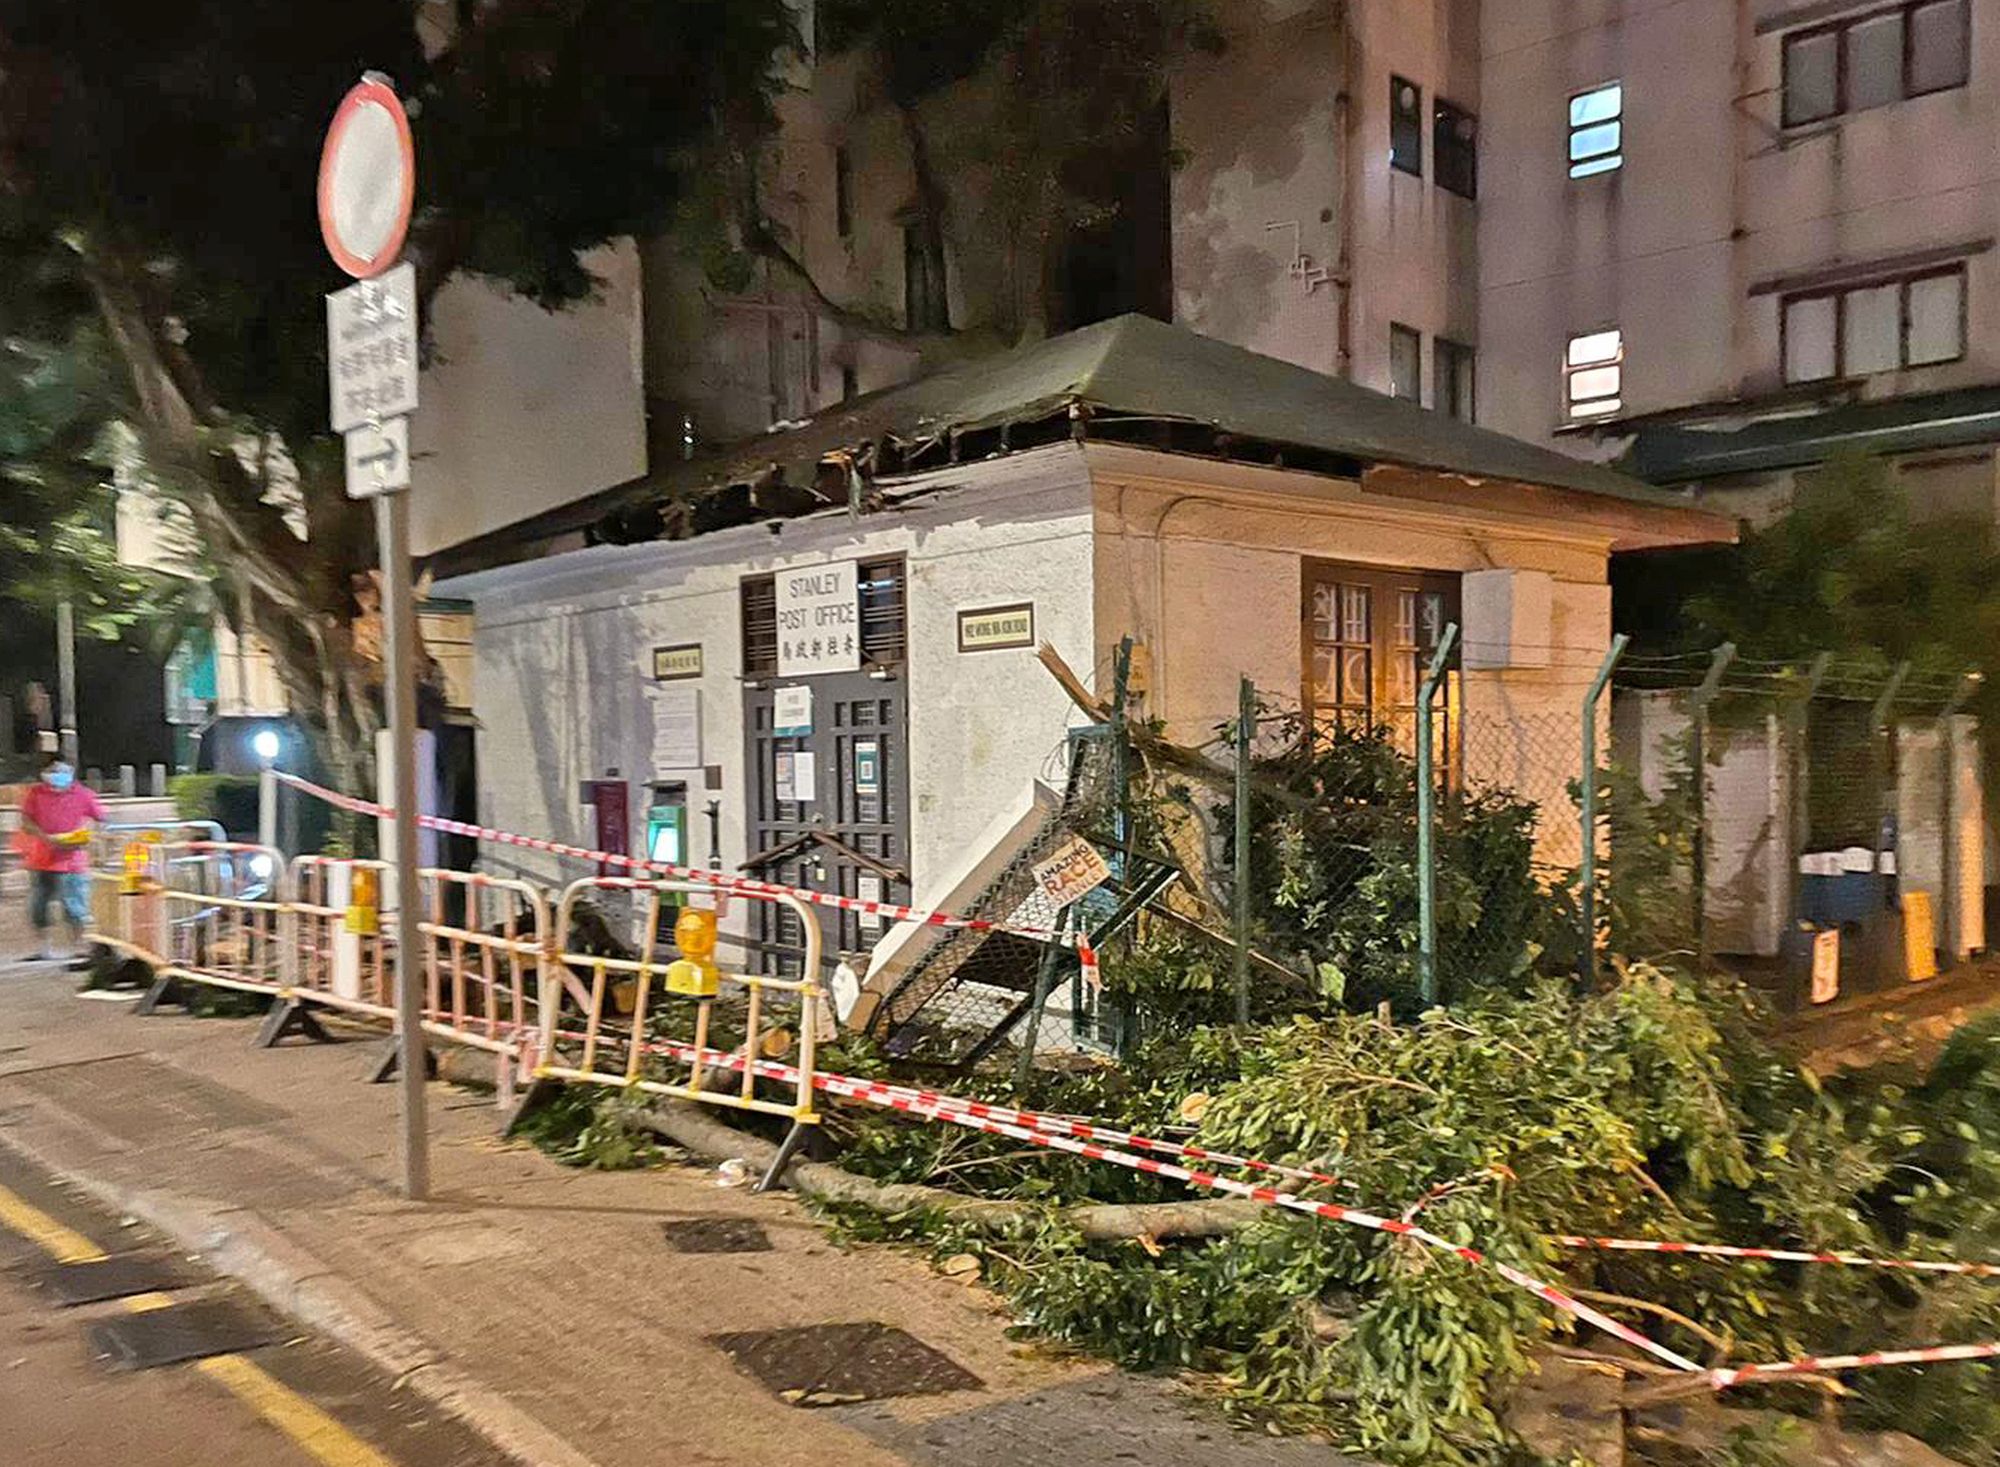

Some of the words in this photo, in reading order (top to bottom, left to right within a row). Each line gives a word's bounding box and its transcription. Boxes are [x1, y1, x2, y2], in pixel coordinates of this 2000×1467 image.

[790, 572, 842, 598] STANLEY
[779, 607, 808, 630] POST
[815, 602, 855, 627] OFFICE
[1040, 843, 1089, 881] AMAZING
[1044, 850, 1099, 896] RACE
